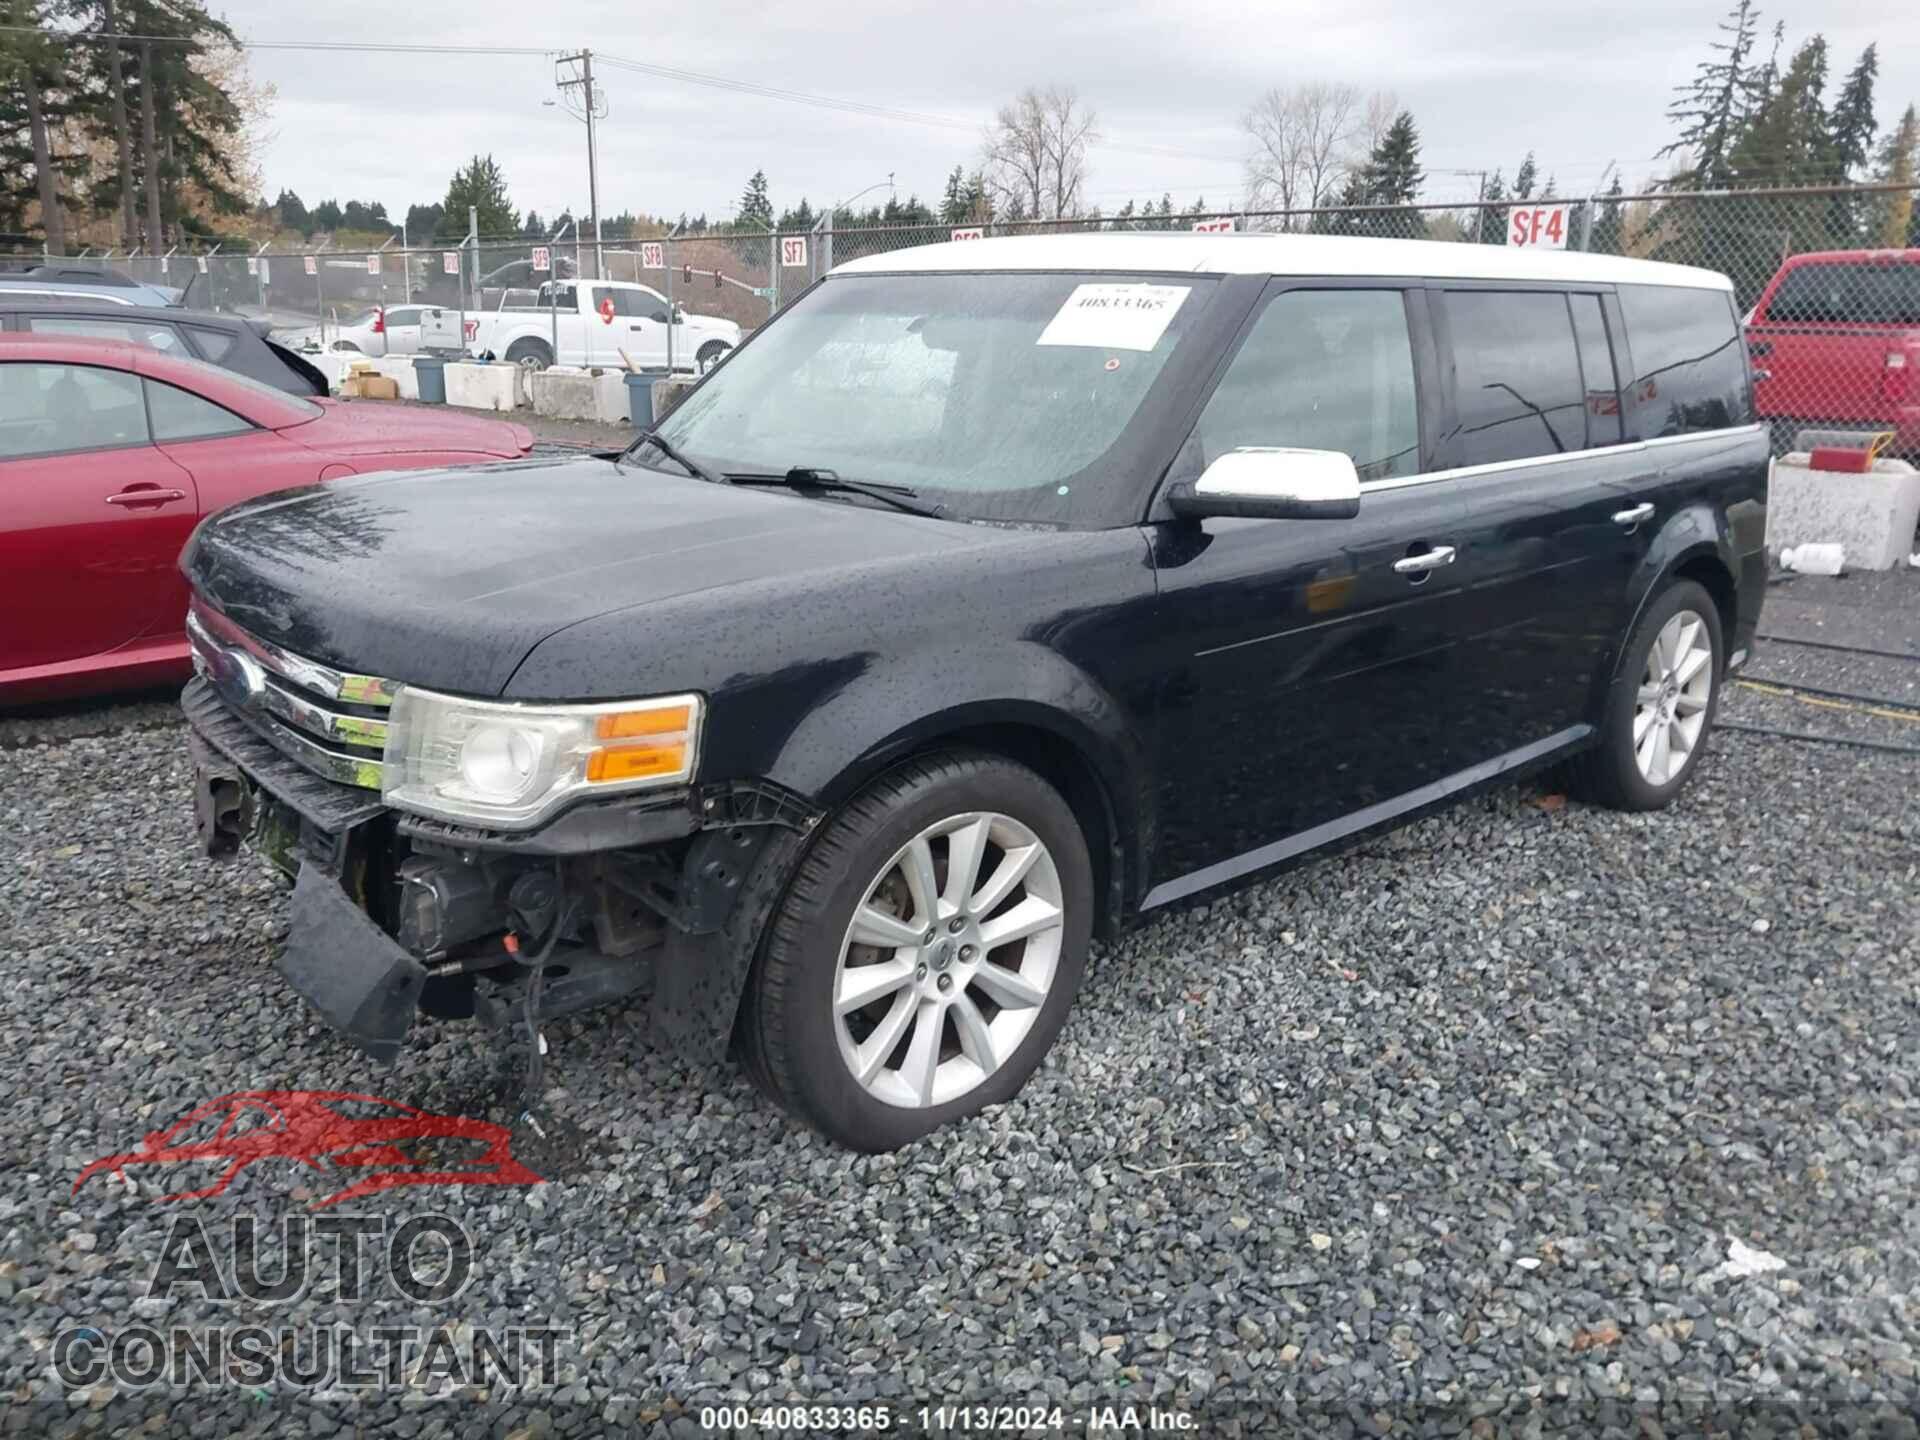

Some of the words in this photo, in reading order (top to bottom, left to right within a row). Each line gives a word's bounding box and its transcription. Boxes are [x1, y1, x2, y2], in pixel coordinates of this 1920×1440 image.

[1512, 209, 1563, 247] SF4
[645, 245, 662, 266] SF8
[784, 240, 804, 263] SF7
